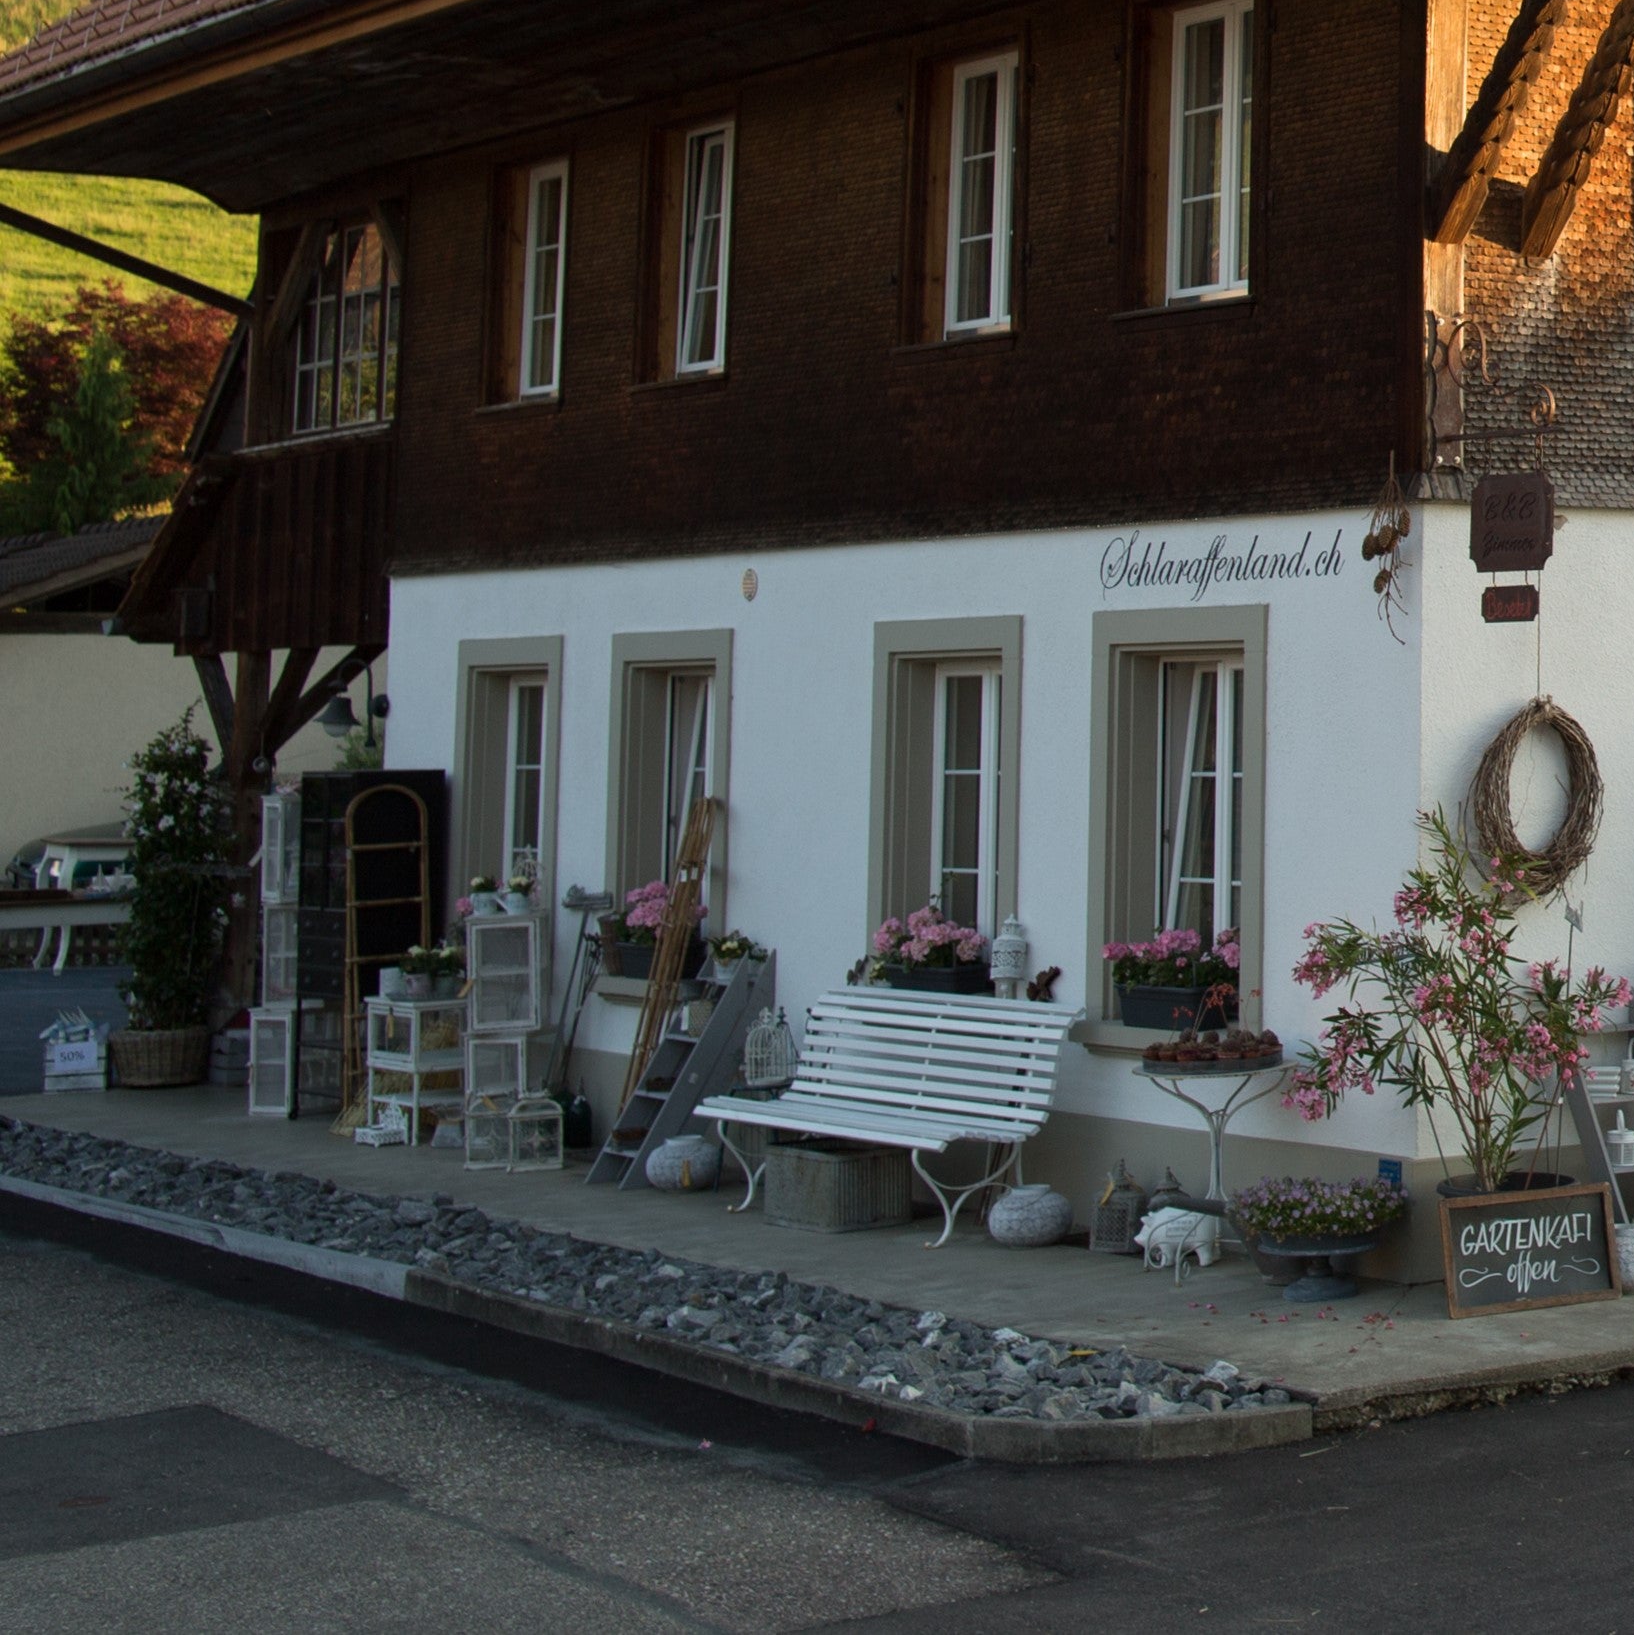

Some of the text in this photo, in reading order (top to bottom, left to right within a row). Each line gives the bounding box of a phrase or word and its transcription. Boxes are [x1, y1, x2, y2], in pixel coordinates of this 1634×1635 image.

[1100, 529, 1345, 601] Schlaraffenland.ch
[1460, 1213, 1591, 1256] GARTENKAFI
[1507, 1250, 1563, 1293] offen
